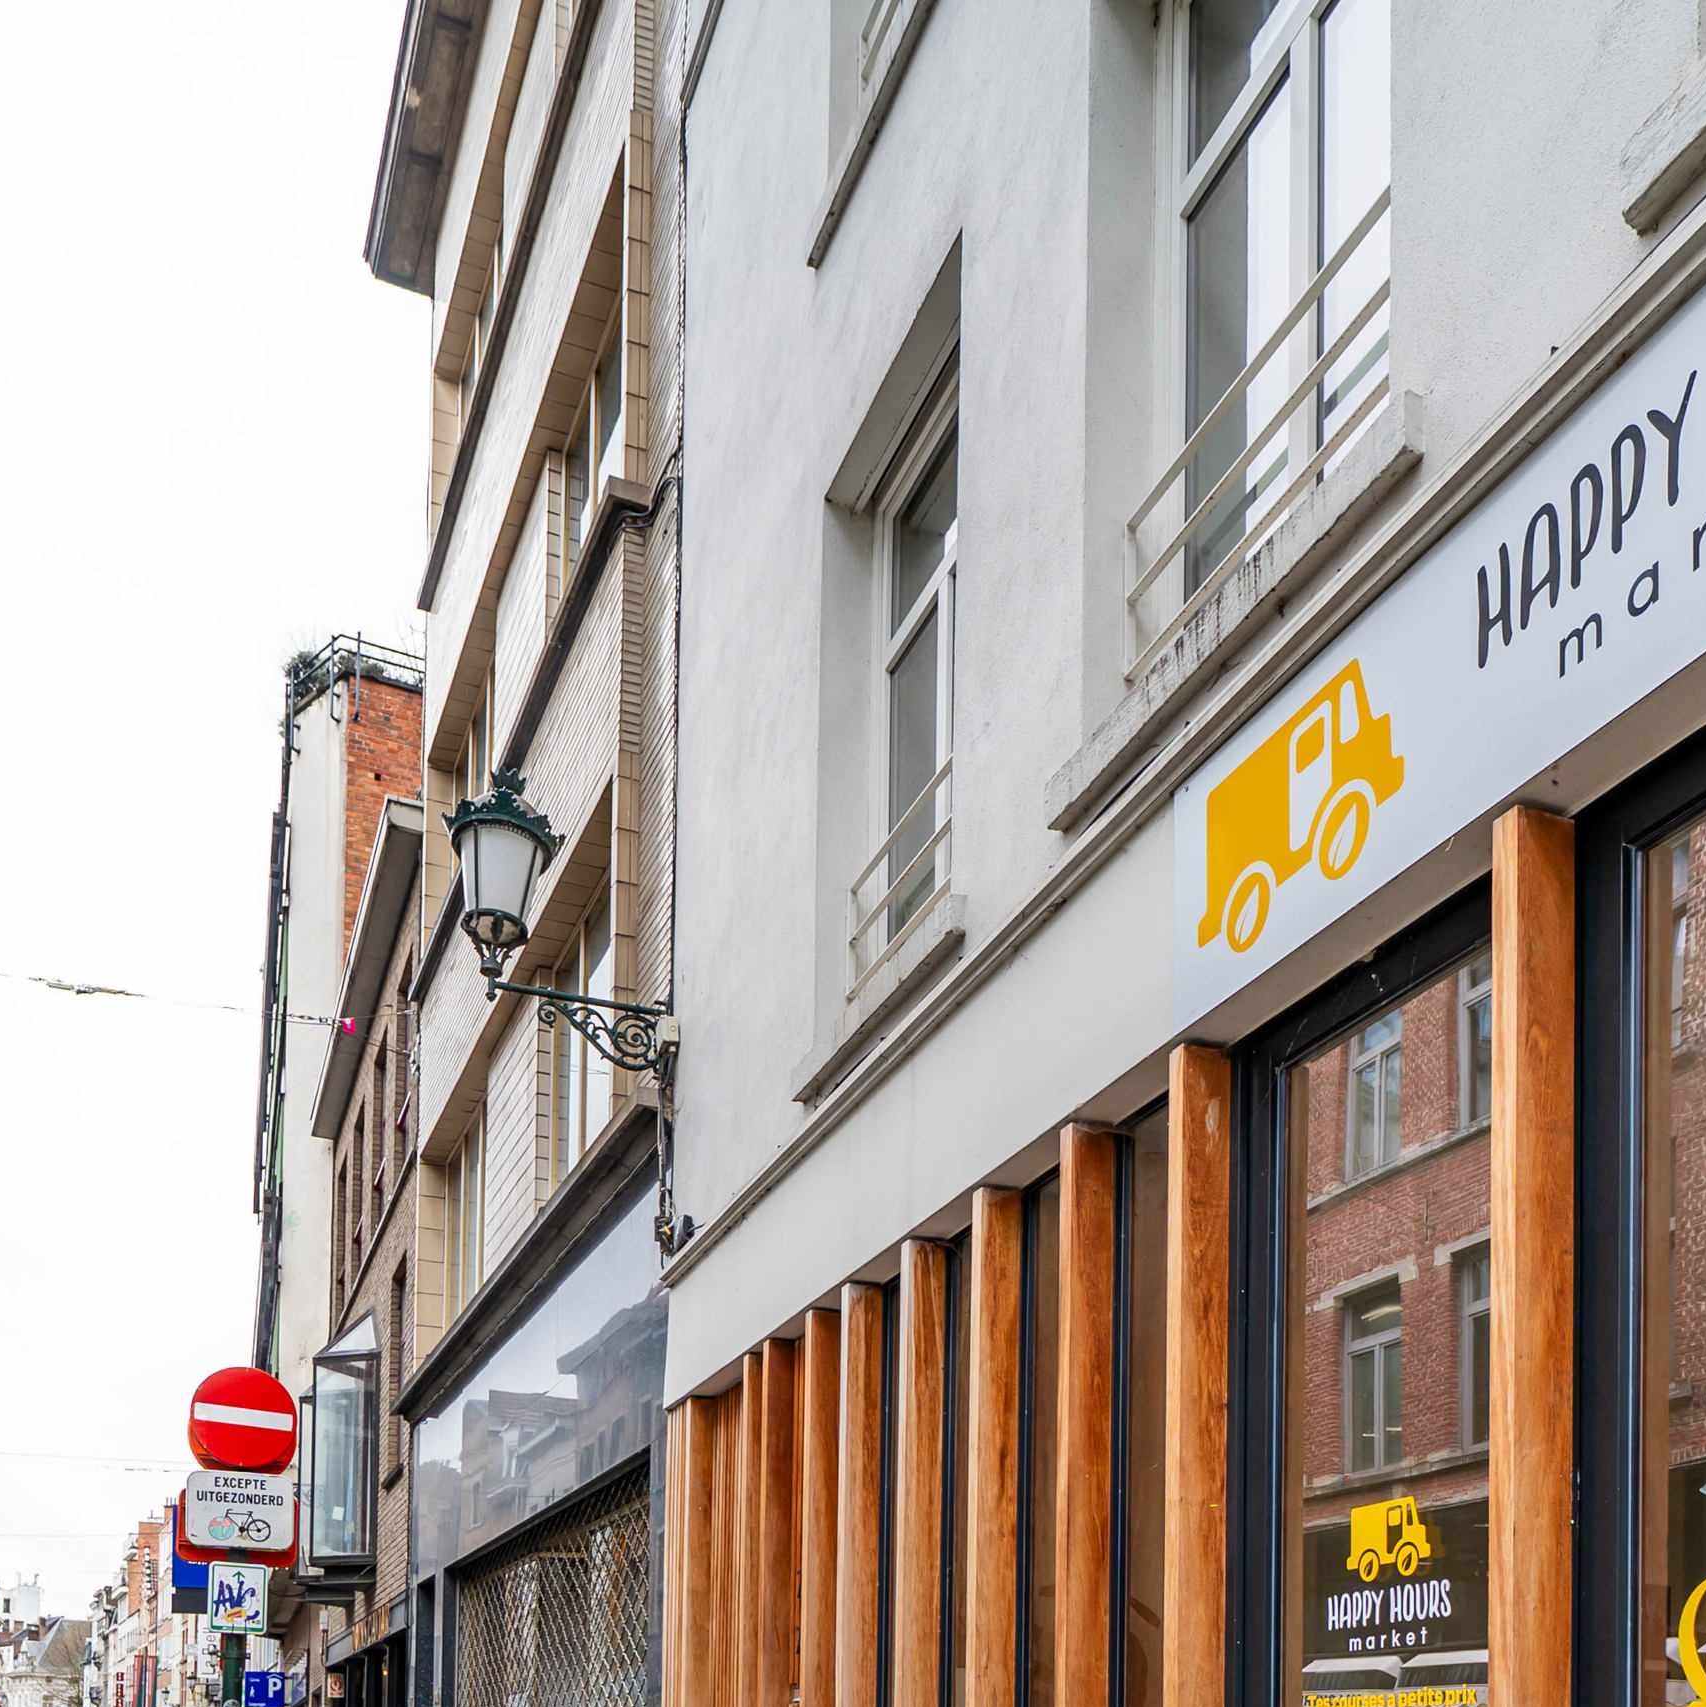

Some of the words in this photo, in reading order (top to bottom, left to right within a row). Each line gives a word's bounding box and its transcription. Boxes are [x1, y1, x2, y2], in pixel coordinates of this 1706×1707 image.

[1475, 370, 1698, 669] HAPPY
[214, 1476, 267, 1490] EXCEPTE
[196, 1490, 284, 1506] UITGEZONDERD
[1327, 1589, 1384, 1631] HAPPY
[1389, 1579, 1451, 1624] HOURS
[1349, 1626, 1428, 1652] market
[268, 1677, 282, 1698] P
